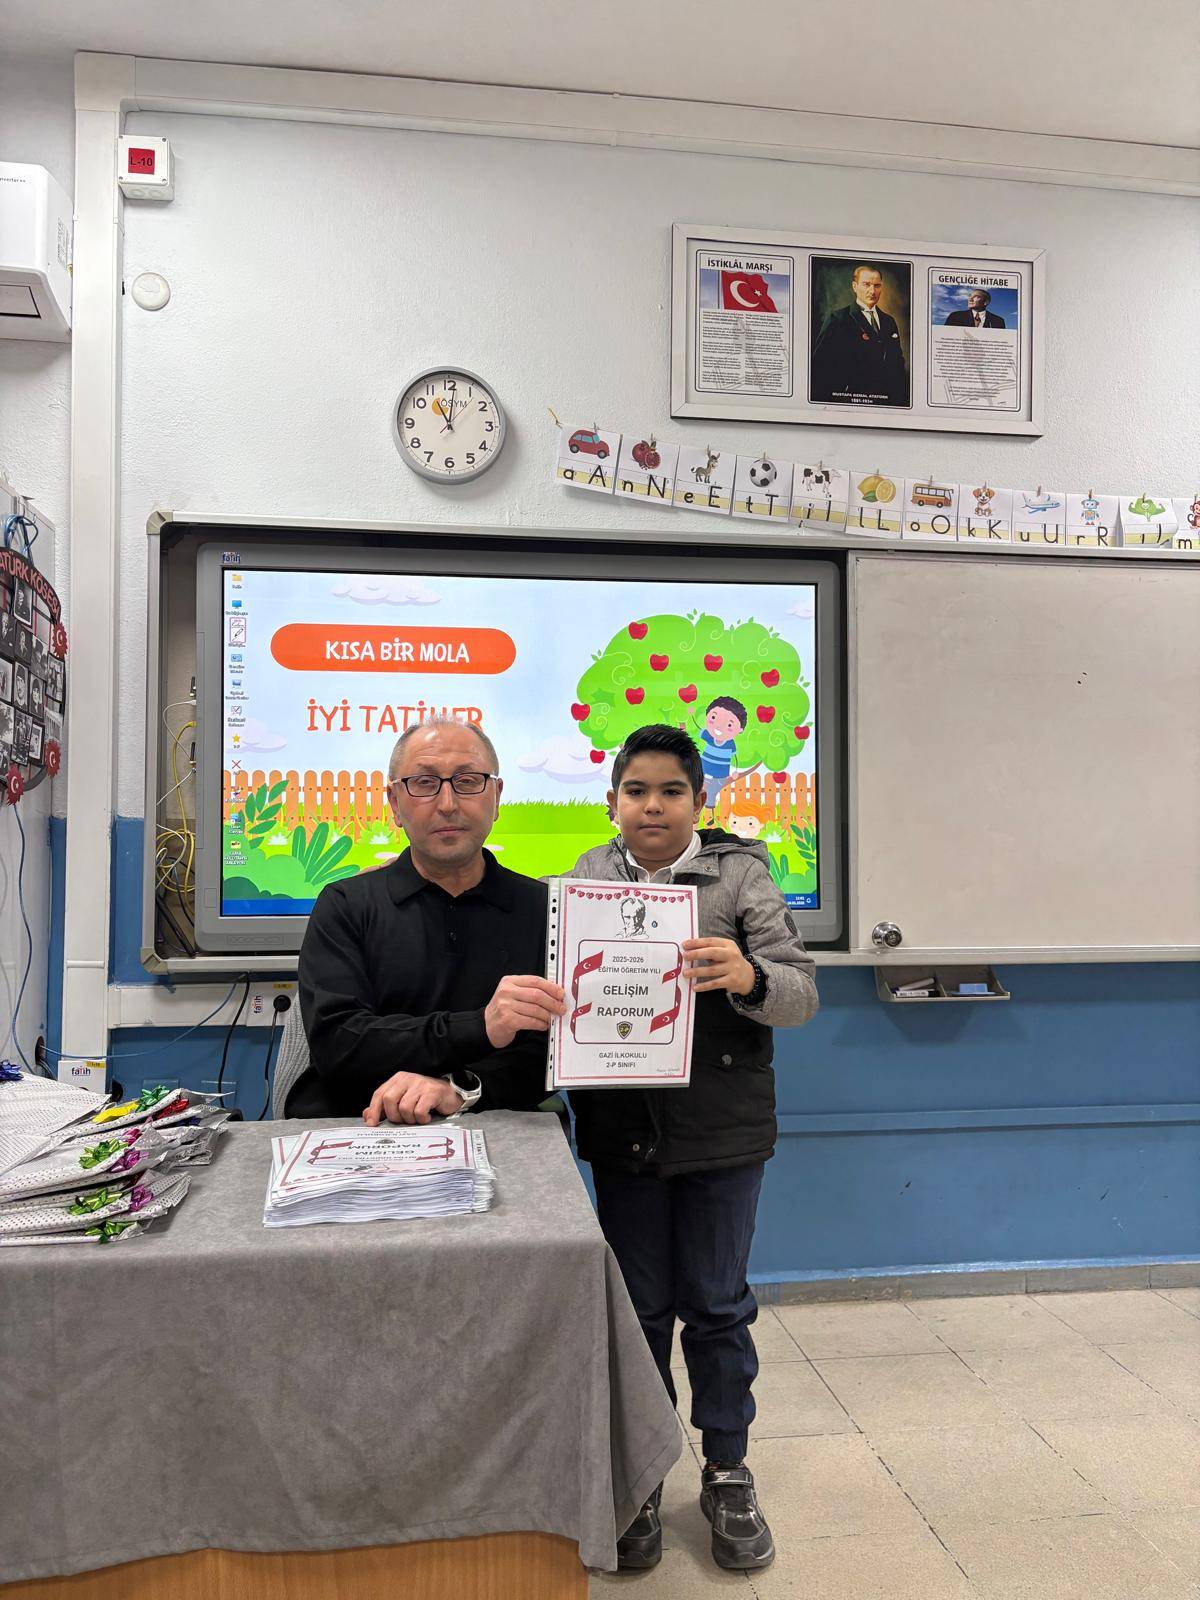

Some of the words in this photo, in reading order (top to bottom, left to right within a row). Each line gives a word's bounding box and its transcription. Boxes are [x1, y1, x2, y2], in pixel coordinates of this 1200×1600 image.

[130, 157, 153, 167] L-10
[707, 258, 743, 270] İSTİKLÂL
[745, 262, 773, 272] MARŞI
[938, 274, 978, 285] GENÇLİĞE
[980, 277, 1009, 287] HİTABE
[426, 384, 434, 396] 11
[468, 386, 472, 398] 1
[444, 379, 457, 391] 12
[412, 397, 427, 409] 10
[478, 400, 488, 412] 2
[440, 398, 467, 408] ÖSYM
[404, 417, 415, 429] 9
[485, 421, 494, 432] 3
[410, 437, 421, 449] 8
[478, 440, 488, 452] 4
[423, 451, 434, 463] 7
[466, 452, 475, 464] 5
[444, 457, 455, 468] 6
[588, 464, 606, 488] A
[623, 480, 634, 492] n
[647, 474, 666, 498] N
[684, 492, 694, 503] e
[708, 485, 722, 508] E
[746, 496, 753, 513] t
[765, 493, 779, 516] T
[877, 509, 890, 531] L
[931, 514, 950, 535] O
[988, 519, 1002, 539] K
[1043, 523, 1058, 544] U
[1076, 535, 1085, 546] r
[1097, 526, 1108, 546] R
[1177, 538, 1192, 549] m
[325, 640, 376, 662] KISA
[380, 637, 415, 662] BİR
[419, 642, 470, 663] MOLA
[307, 698, 351, 732] İYİ
[598, 966, 620, 974] EĞİTİM
[620, 966, 649, 974] ÖĞRETİM
[603, 983, 649, 998] GELİŞİM
[597, 1006, 654, 1018] RAPORUM
[598, 1051, 614, 1059] GAZİ
[614, 1051, 648, 1059] İLKOKULU
